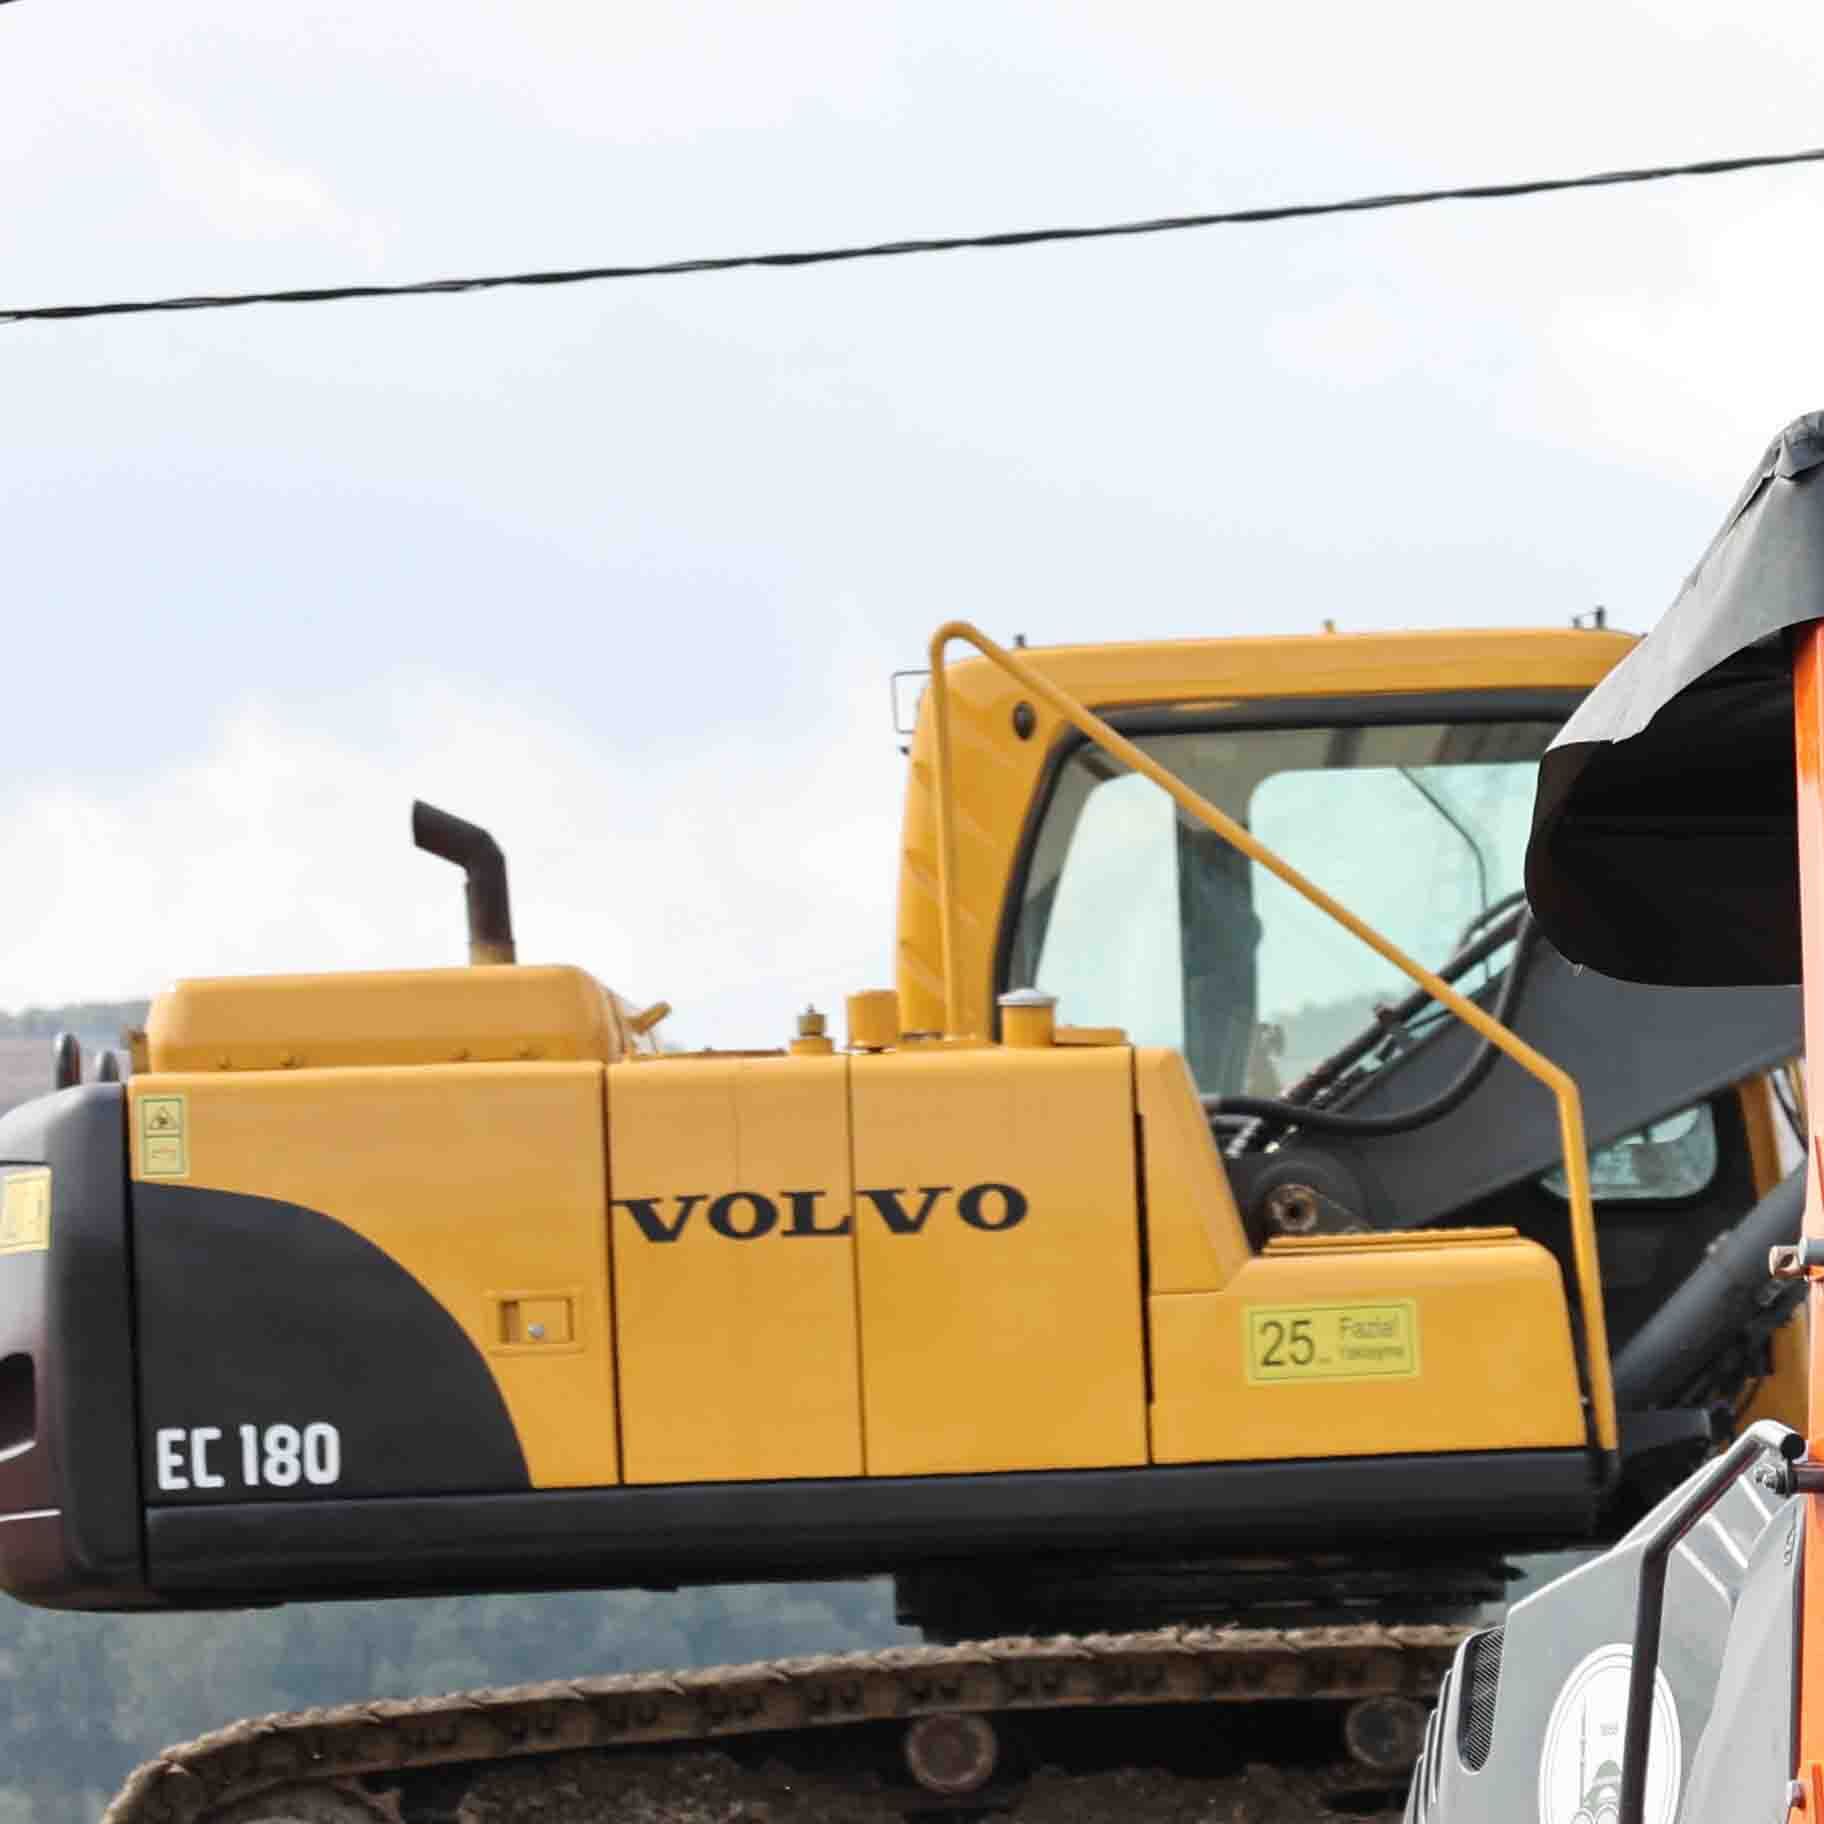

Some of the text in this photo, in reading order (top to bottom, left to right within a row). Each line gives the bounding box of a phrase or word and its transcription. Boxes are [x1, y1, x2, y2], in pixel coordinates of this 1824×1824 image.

[612, 1183, 1029, 1243] VOLVO
[1260, 1320, 1315, 1366] 25
[156, 1422, 340, 1490] EC 180
